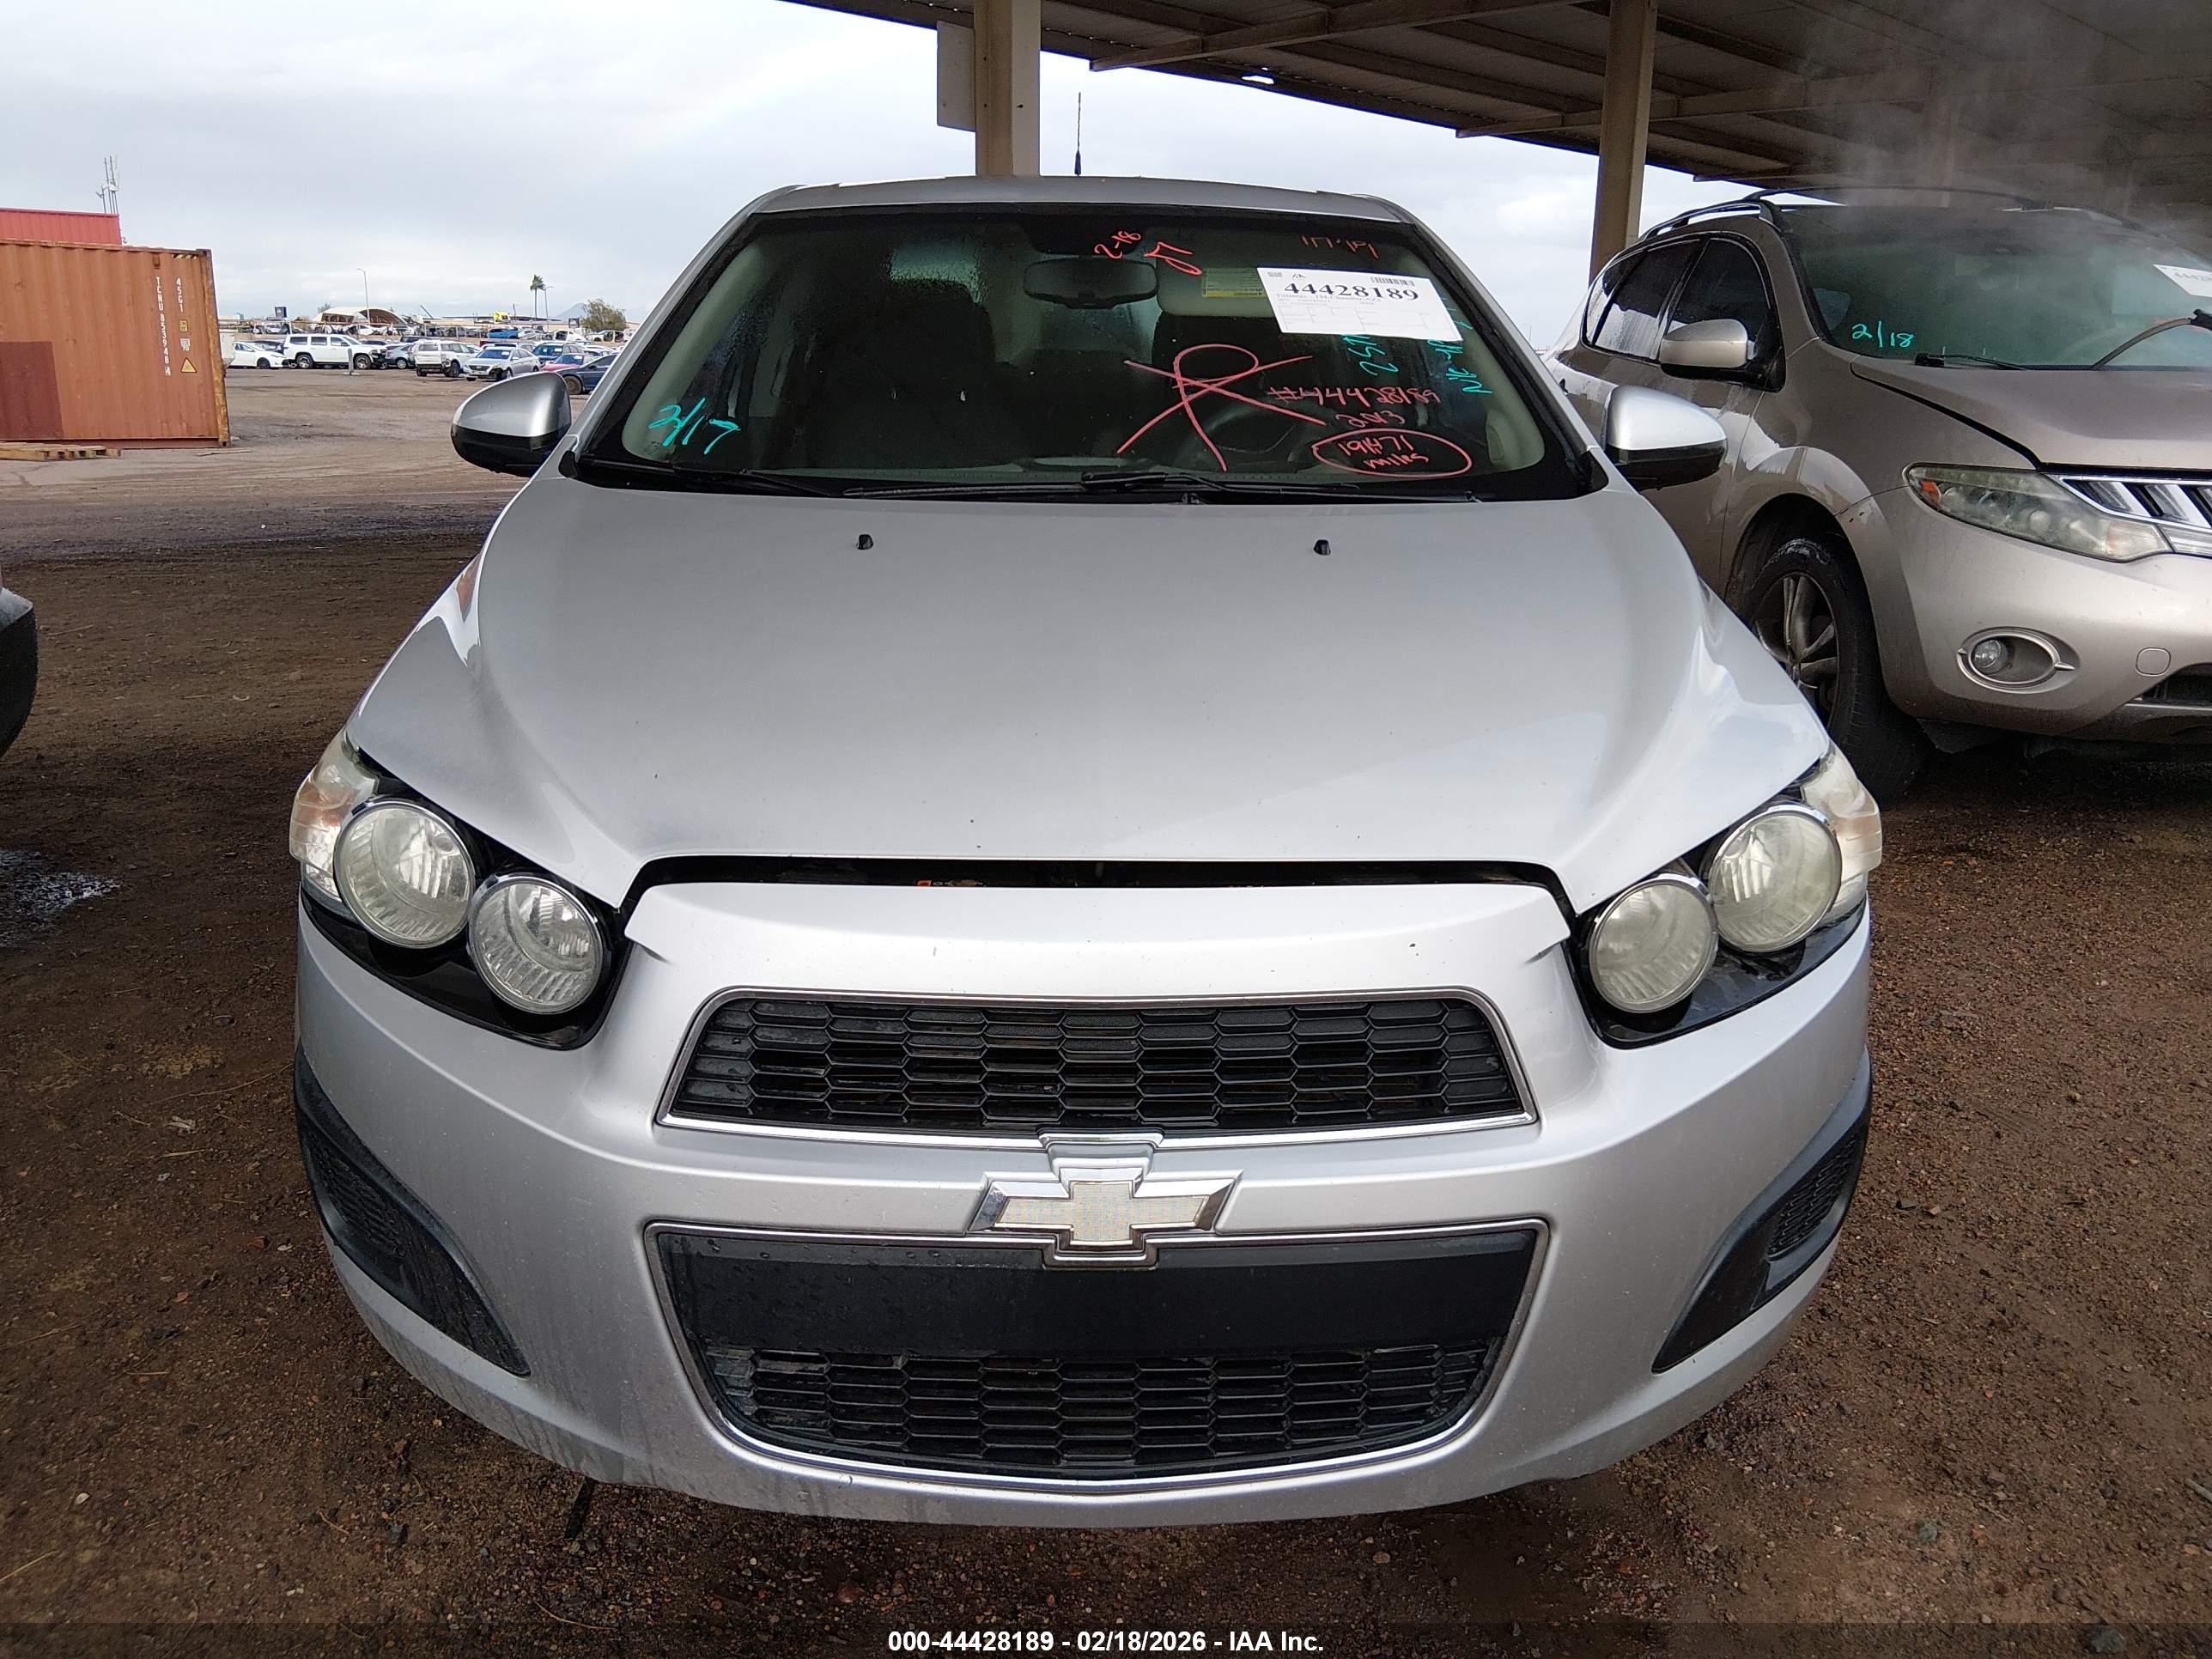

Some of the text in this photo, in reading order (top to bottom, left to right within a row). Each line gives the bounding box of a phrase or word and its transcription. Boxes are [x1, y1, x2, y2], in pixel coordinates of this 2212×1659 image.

[155, 276, 164, 311] TCNU
[1285, 283, 1419, 301] 44428189
[1851, 320, 1915, 348] 2/18
[647, 398, 742, 455] 2/17
